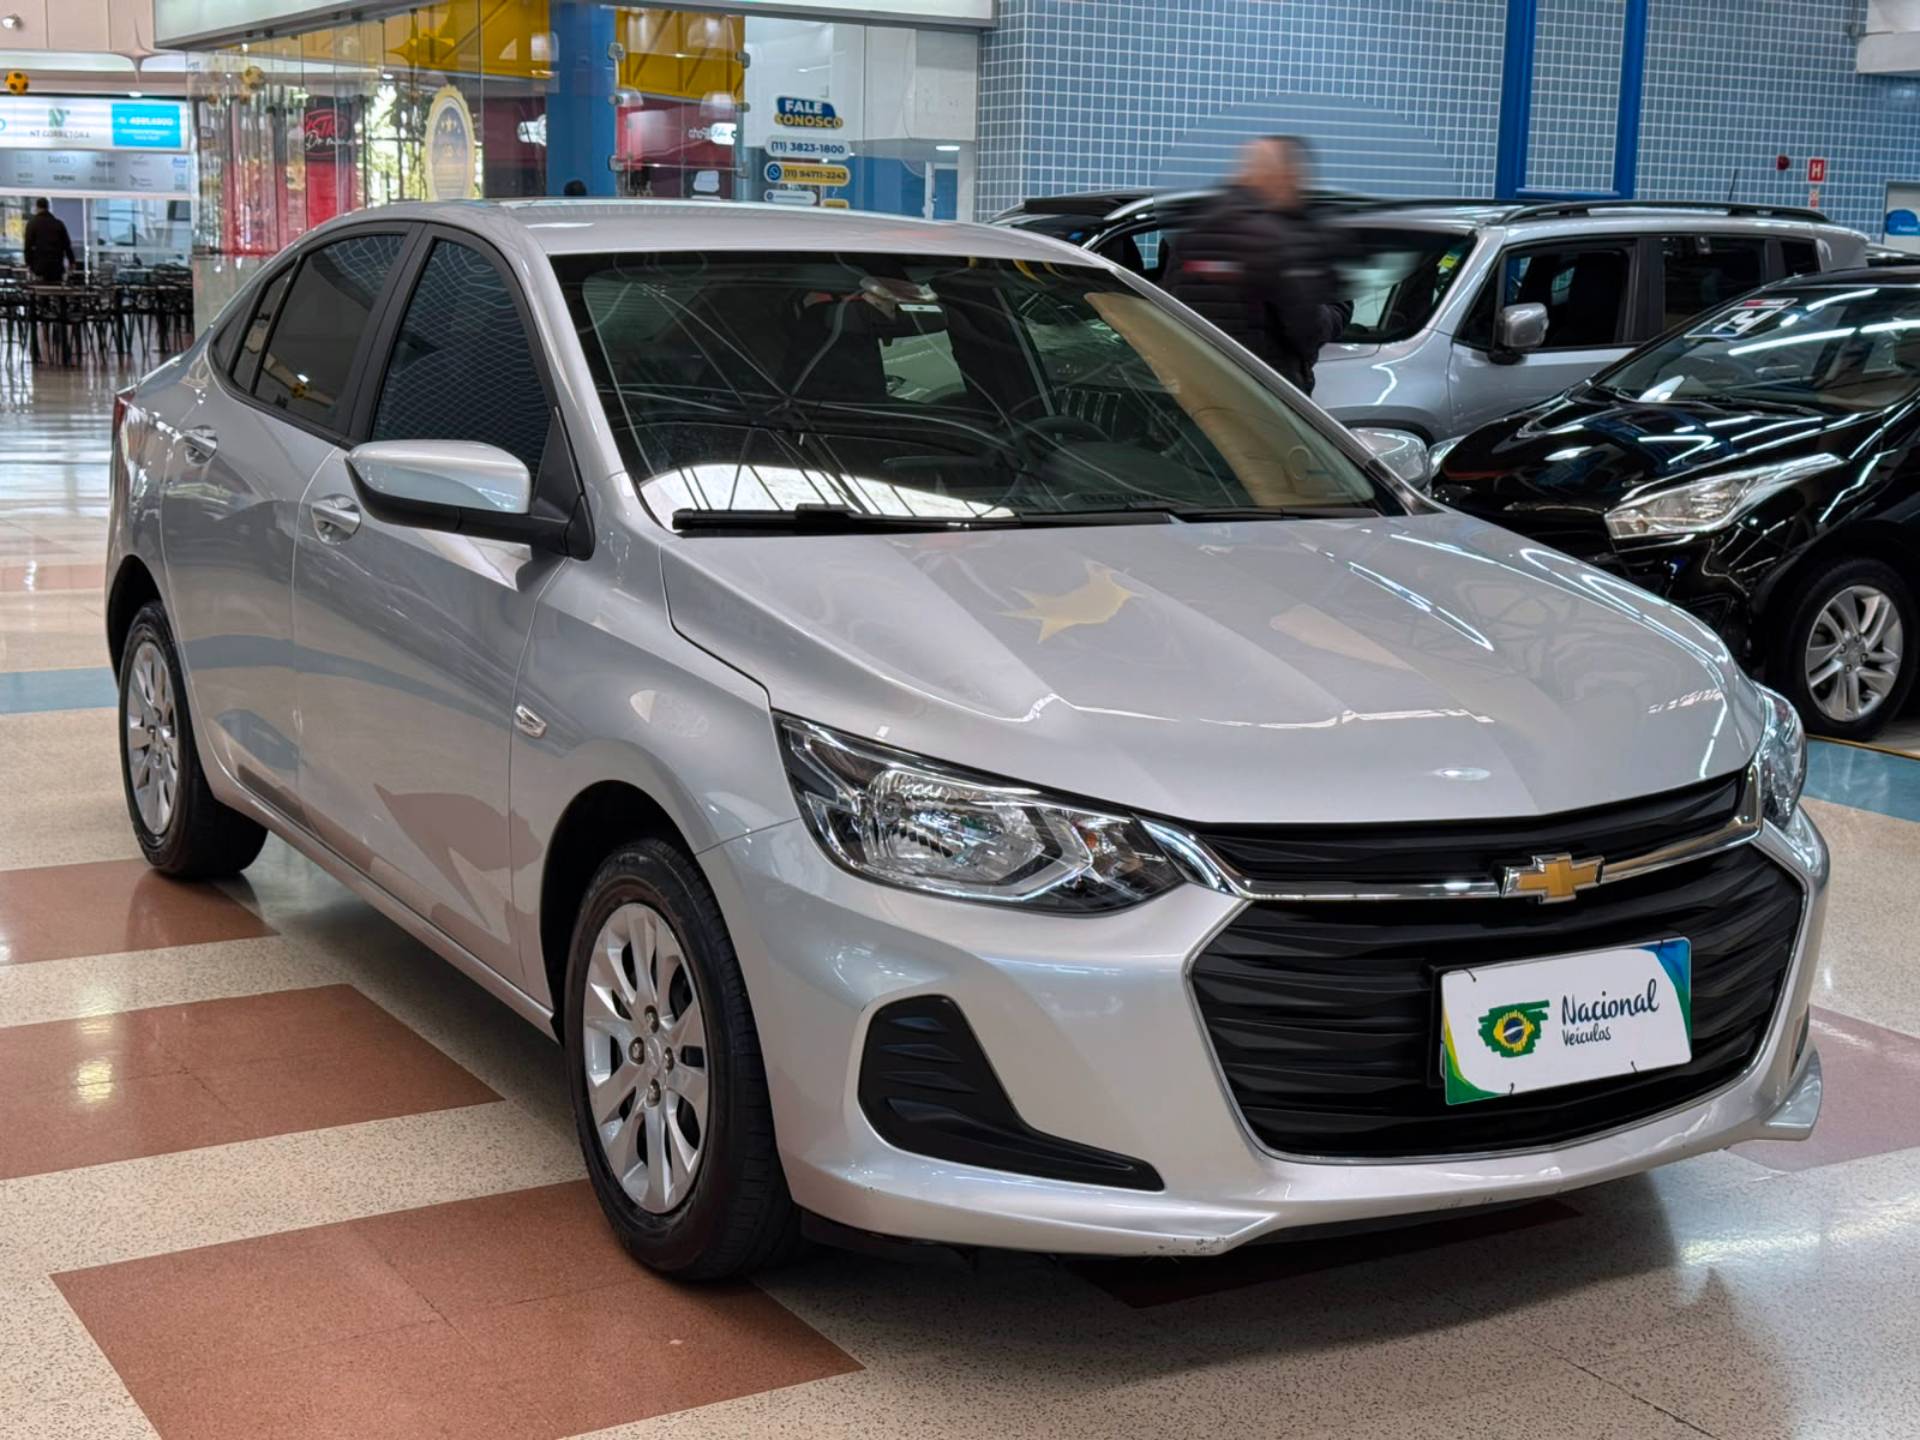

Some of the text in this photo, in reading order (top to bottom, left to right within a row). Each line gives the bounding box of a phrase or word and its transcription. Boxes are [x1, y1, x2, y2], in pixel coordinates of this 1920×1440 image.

[785, 100, 823, 114] FALE
[775, 112, 843, 128] CONOSCO
[771, 141, 845, 154] (11) 3823-1800
[1811, 162, 1823, 179] H
[1562, 978, 1659, 1025] Nacional
